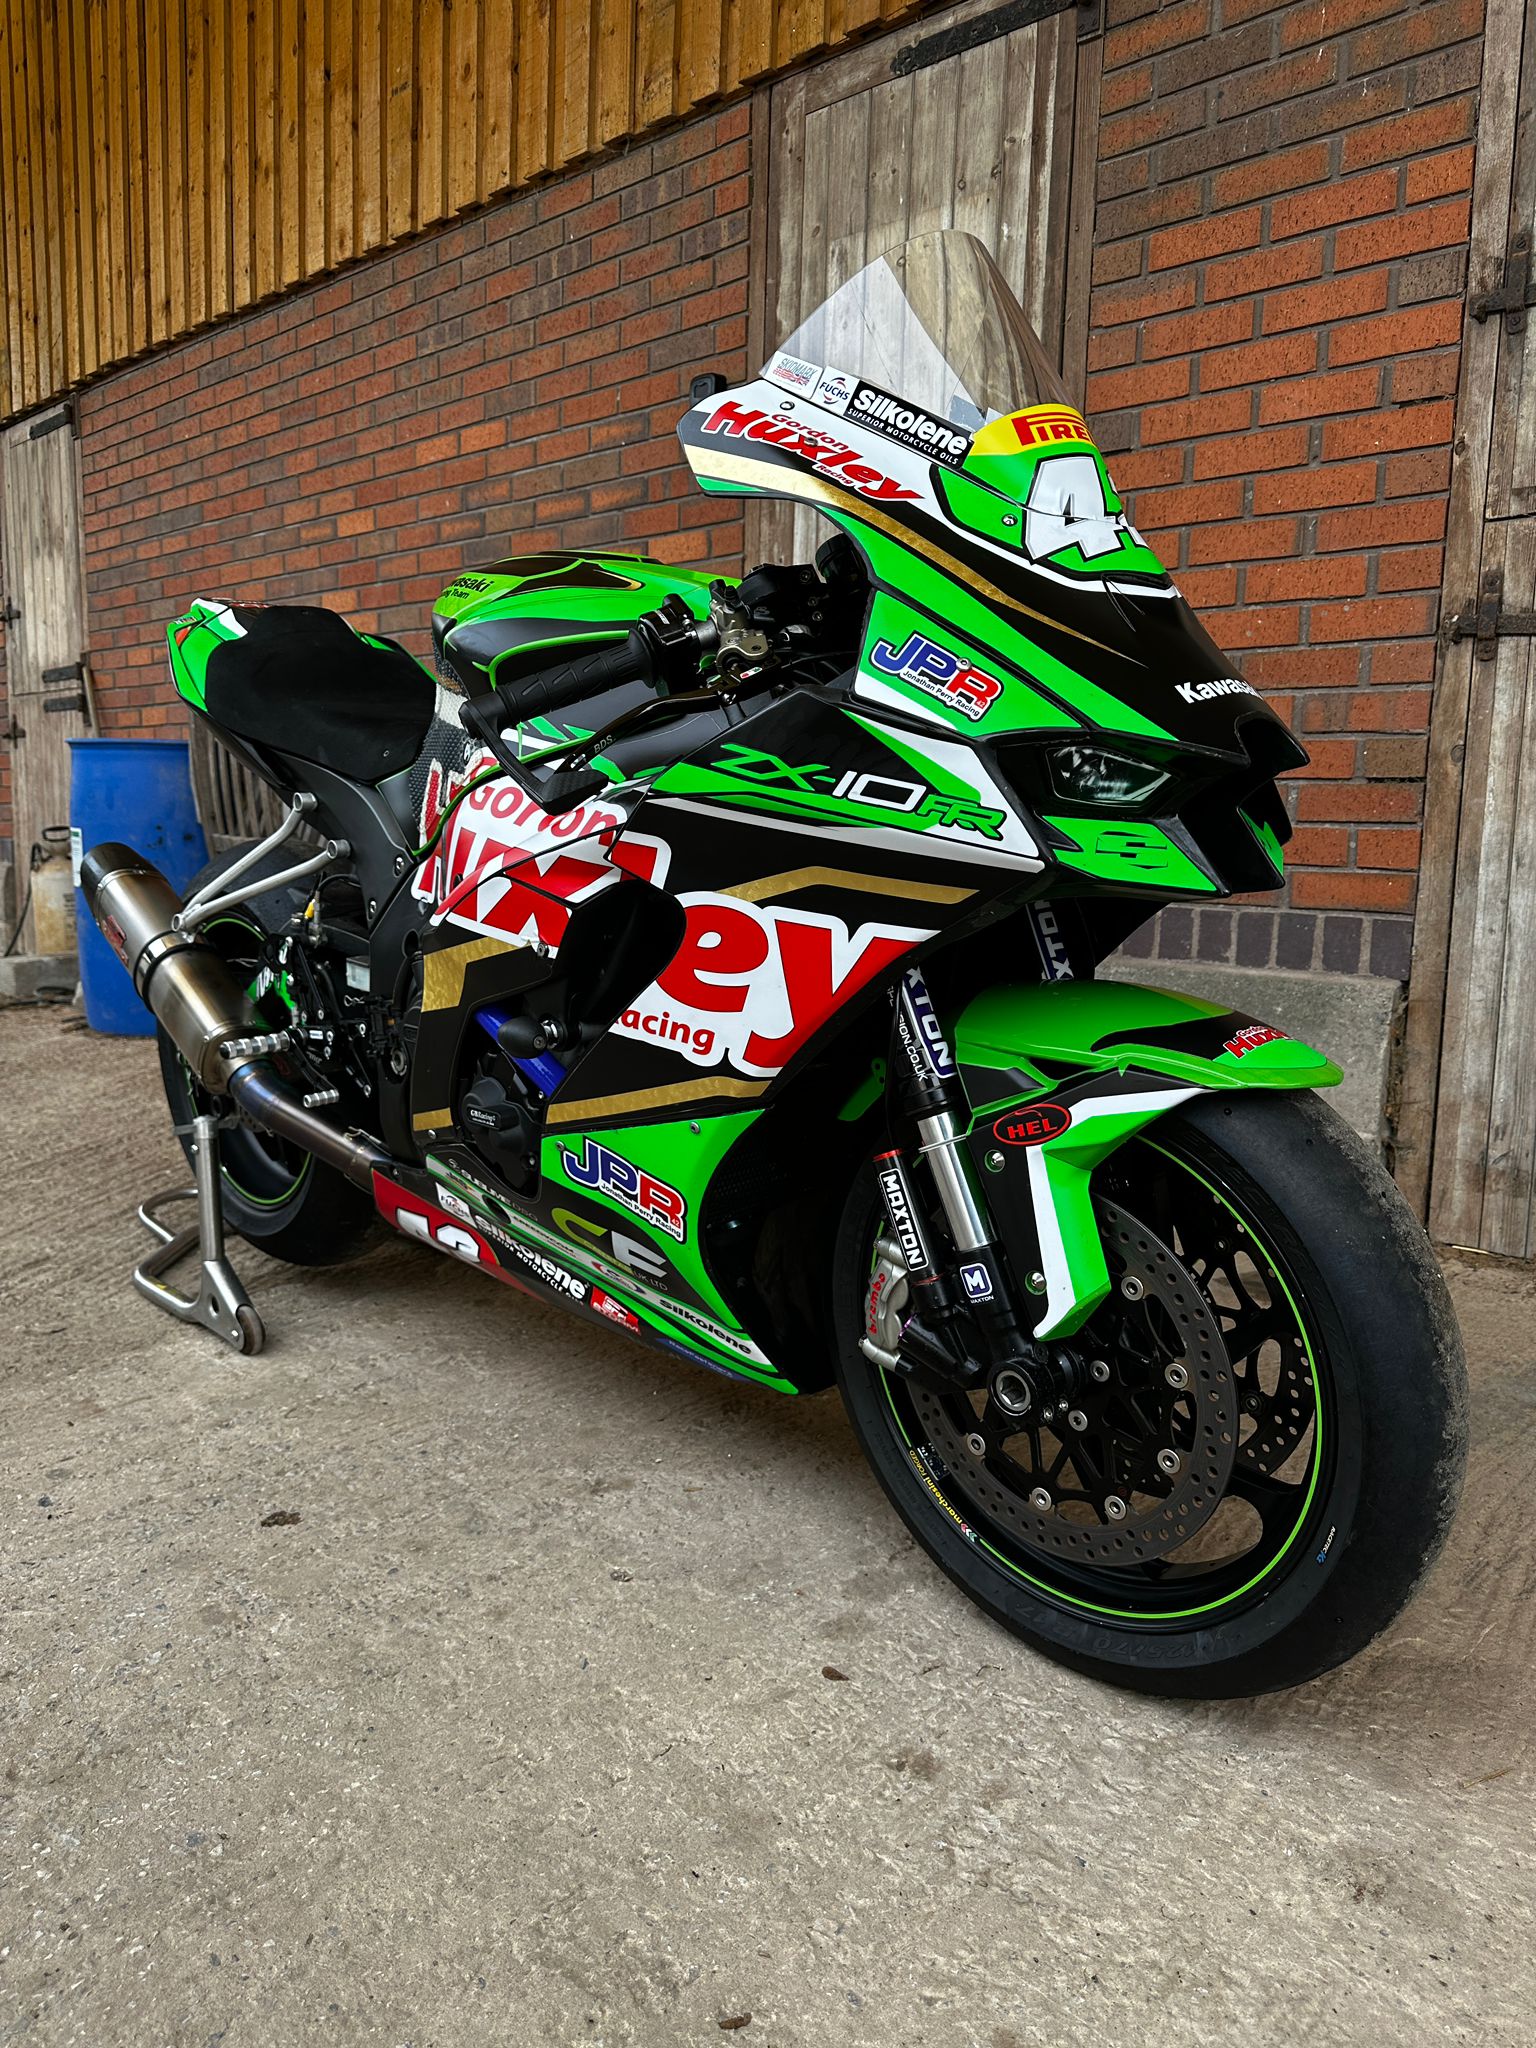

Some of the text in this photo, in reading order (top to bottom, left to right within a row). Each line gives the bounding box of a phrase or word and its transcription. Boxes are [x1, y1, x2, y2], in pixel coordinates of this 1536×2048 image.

[819, 381, 850, 401] FUCHS
[771, 414, 850, 450] Gordon
[847, 407, 959, 465] SUPERIOR MOTORCYCLE OILS
[853, 389, 968, 455] Silkolene
[1012, 412, 1096, 446] PIRE
[704, 401, 926, 499] Huxley
[816, 464, 854, 485] Racing
[1026, 457, 1150, 560] 4
[451, 588, 469, 599] Team
[872, 635, 1001, 710] JPR
[902, 670, 980, 717] Jonathan Perry Racing
[613, 1009, 715, 1056] acing
[1007, 1118, 1058, 1139] HEL
[440, 1195, 470, 1218] FUCHS
[565, 1140, 683, 1230] JPR
[601, 1183, 681, 1238] Jonathan Perry Racing
[883, 1174, 923, 1265] MAXTON
[474, 1215, 586, 1300] Silkolene
[517, 1252, 563, 1292] MOTORCYCLE
[869, 1272, 886, 1334] brembo
[970, 1295, 994, 1304] MAXTON
[659, 1298, 752, 1355] Silkolene
[922, 1476, 962, 1524] marchesini
